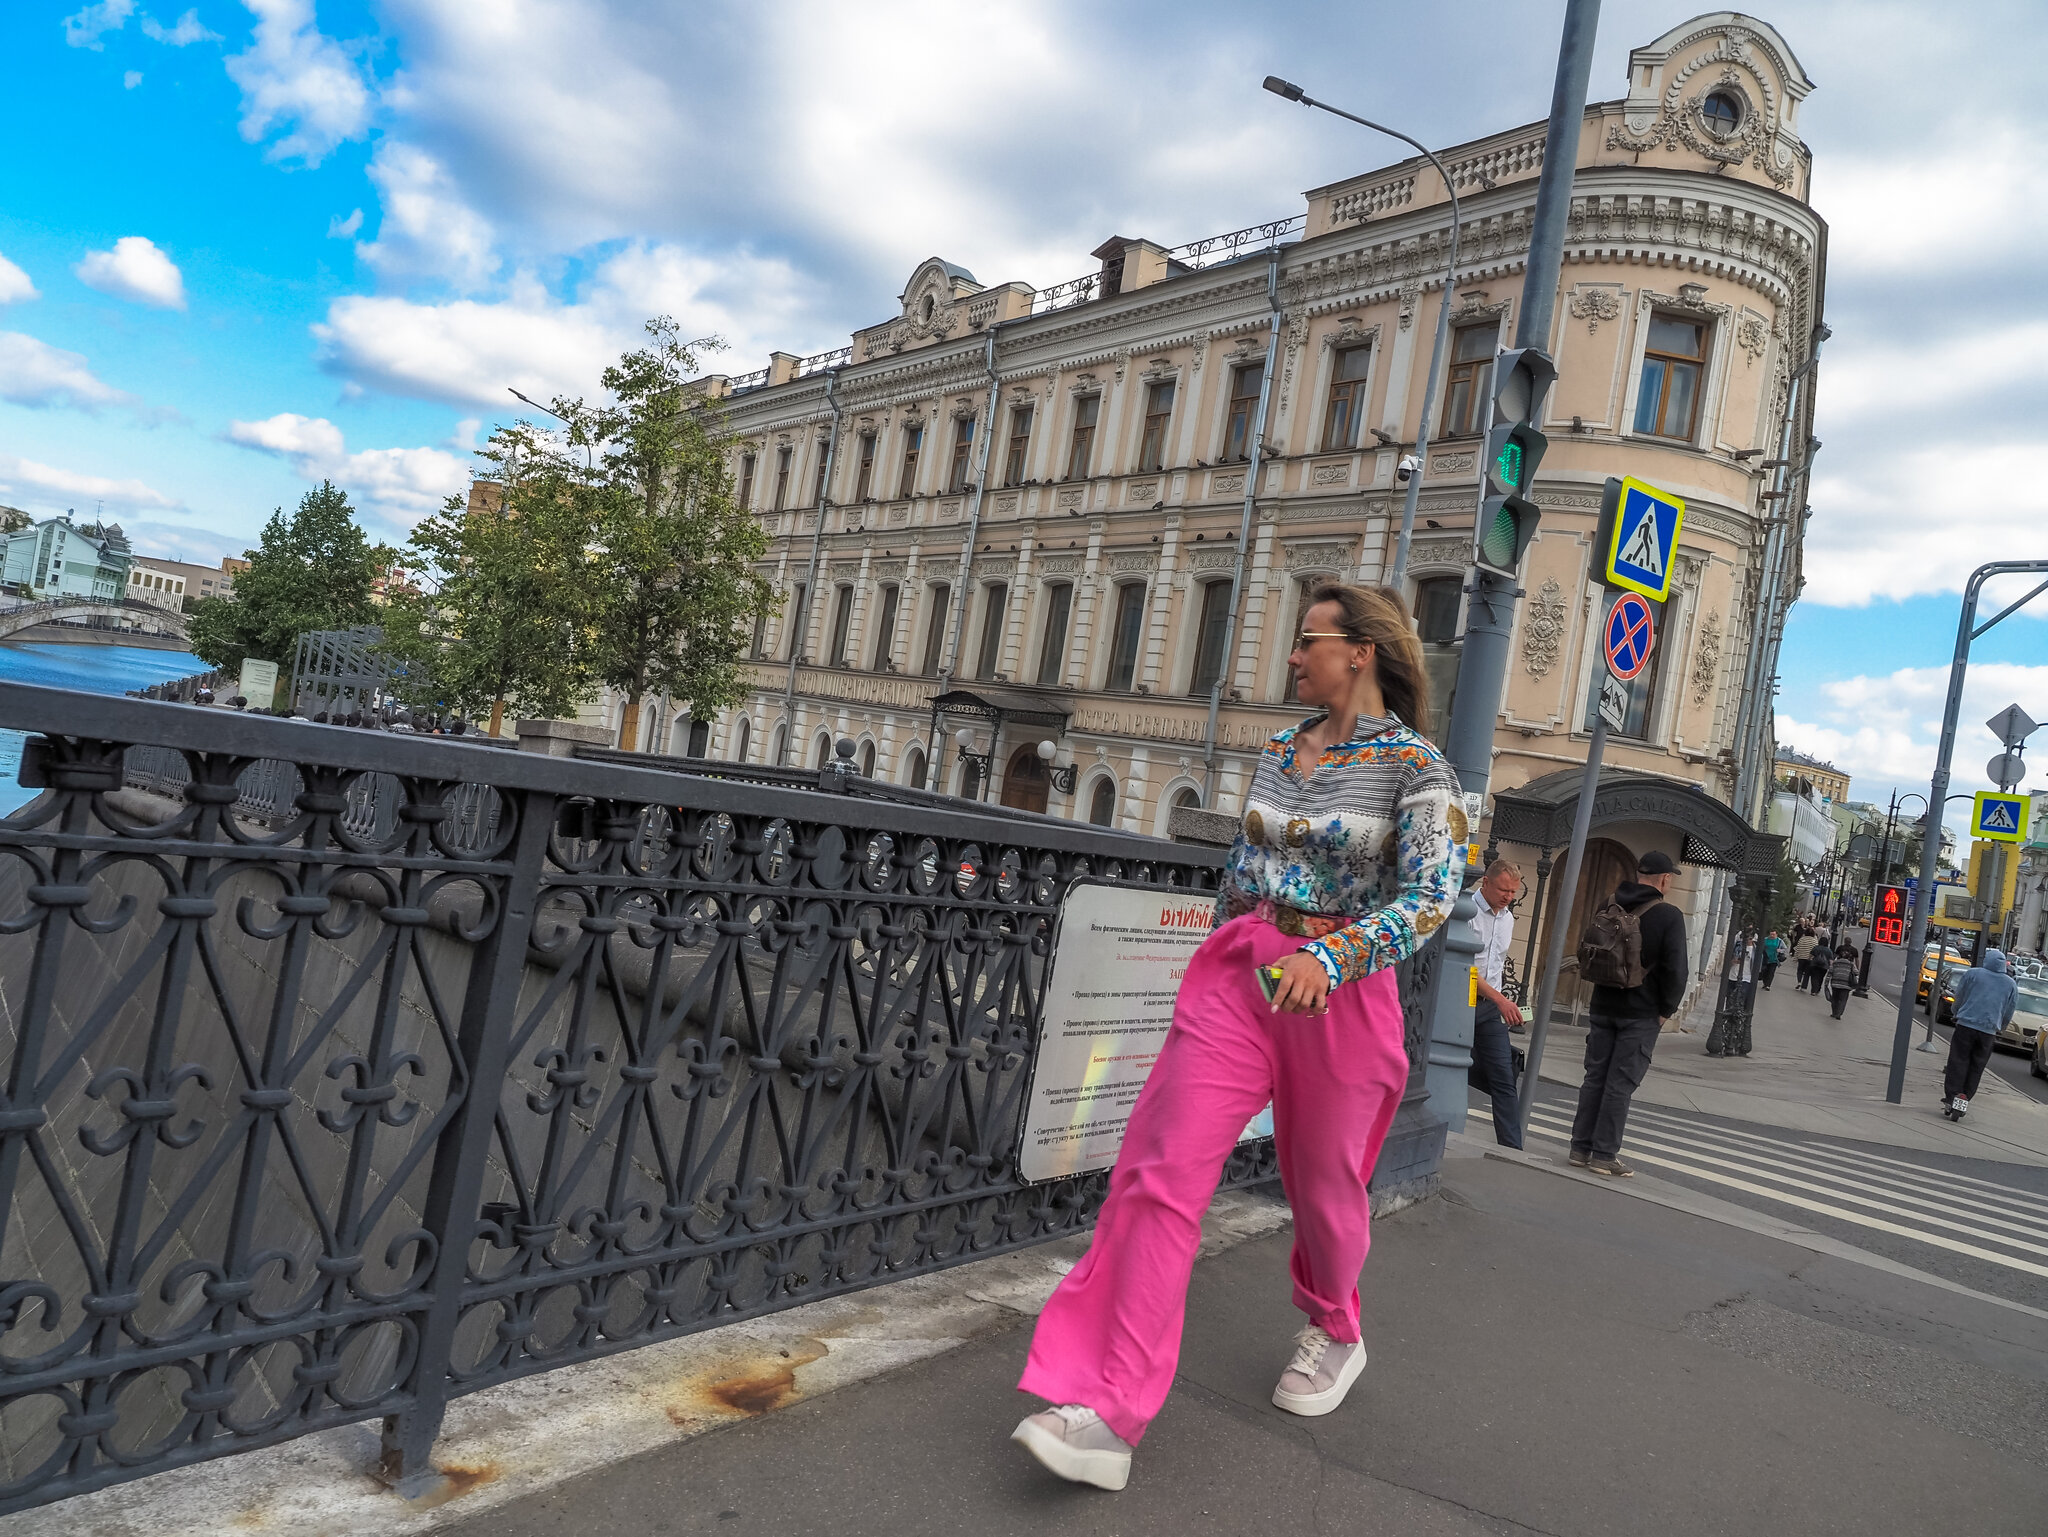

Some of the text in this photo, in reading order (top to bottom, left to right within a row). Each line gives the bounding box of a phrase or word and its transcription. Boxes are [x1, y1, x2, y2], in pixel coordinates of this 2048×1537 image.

[1074, 708, 1119, 732] ПЕТРЪ
[1122, 713, 1231, 745] АРСЕНЬЕВИЪ
[1875, 916, 1903, 944] 88
